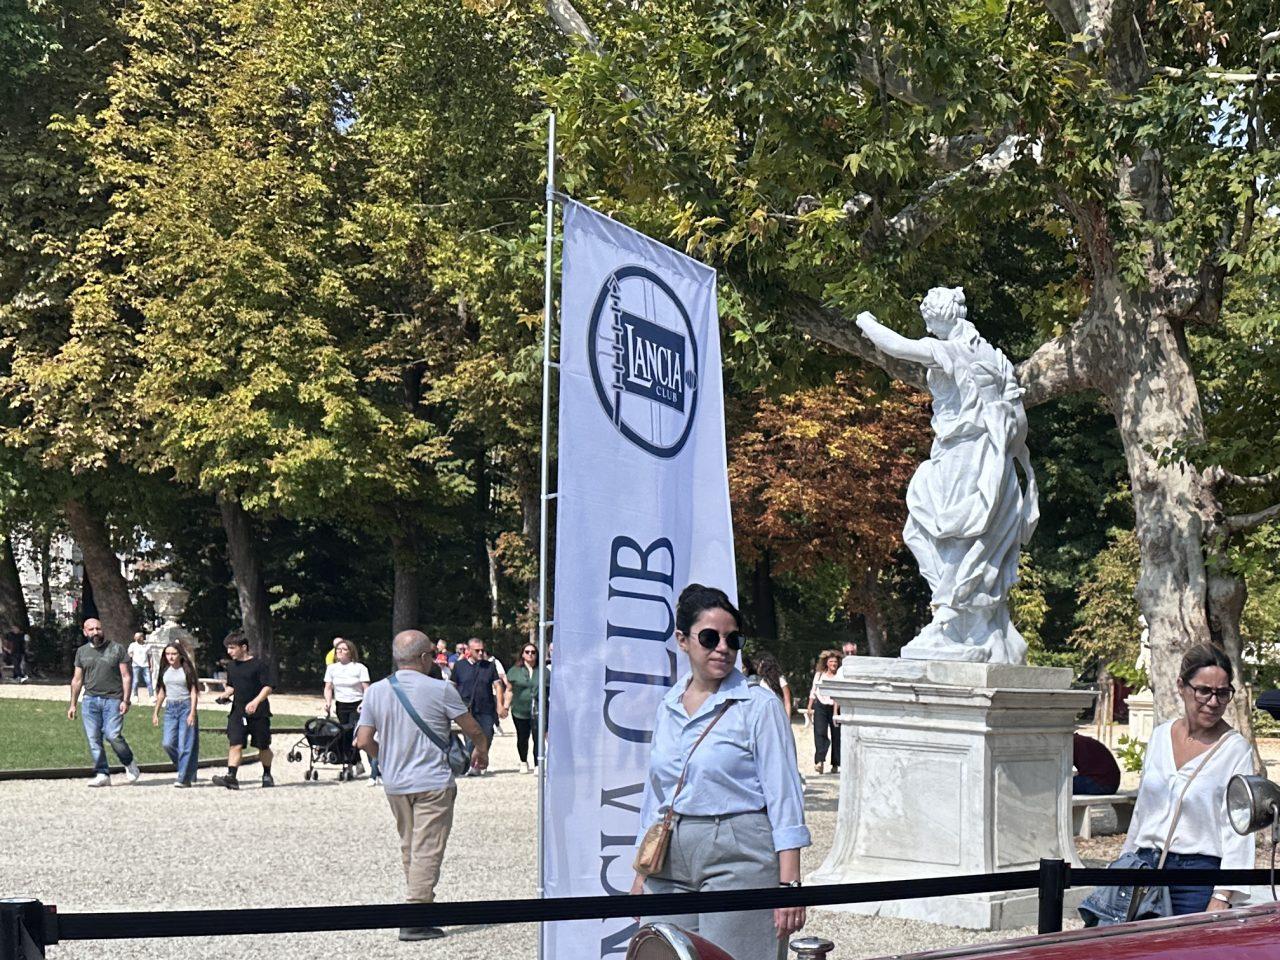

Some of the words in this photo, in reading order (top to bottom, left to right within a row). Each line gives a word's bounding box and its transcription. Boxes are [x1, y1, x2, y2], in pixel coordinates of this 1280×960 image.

[624, 323, 683, 393] LANCIA
[655, 385, 678, 403] CLUB
[603, 535, 678, 744] CLUB
